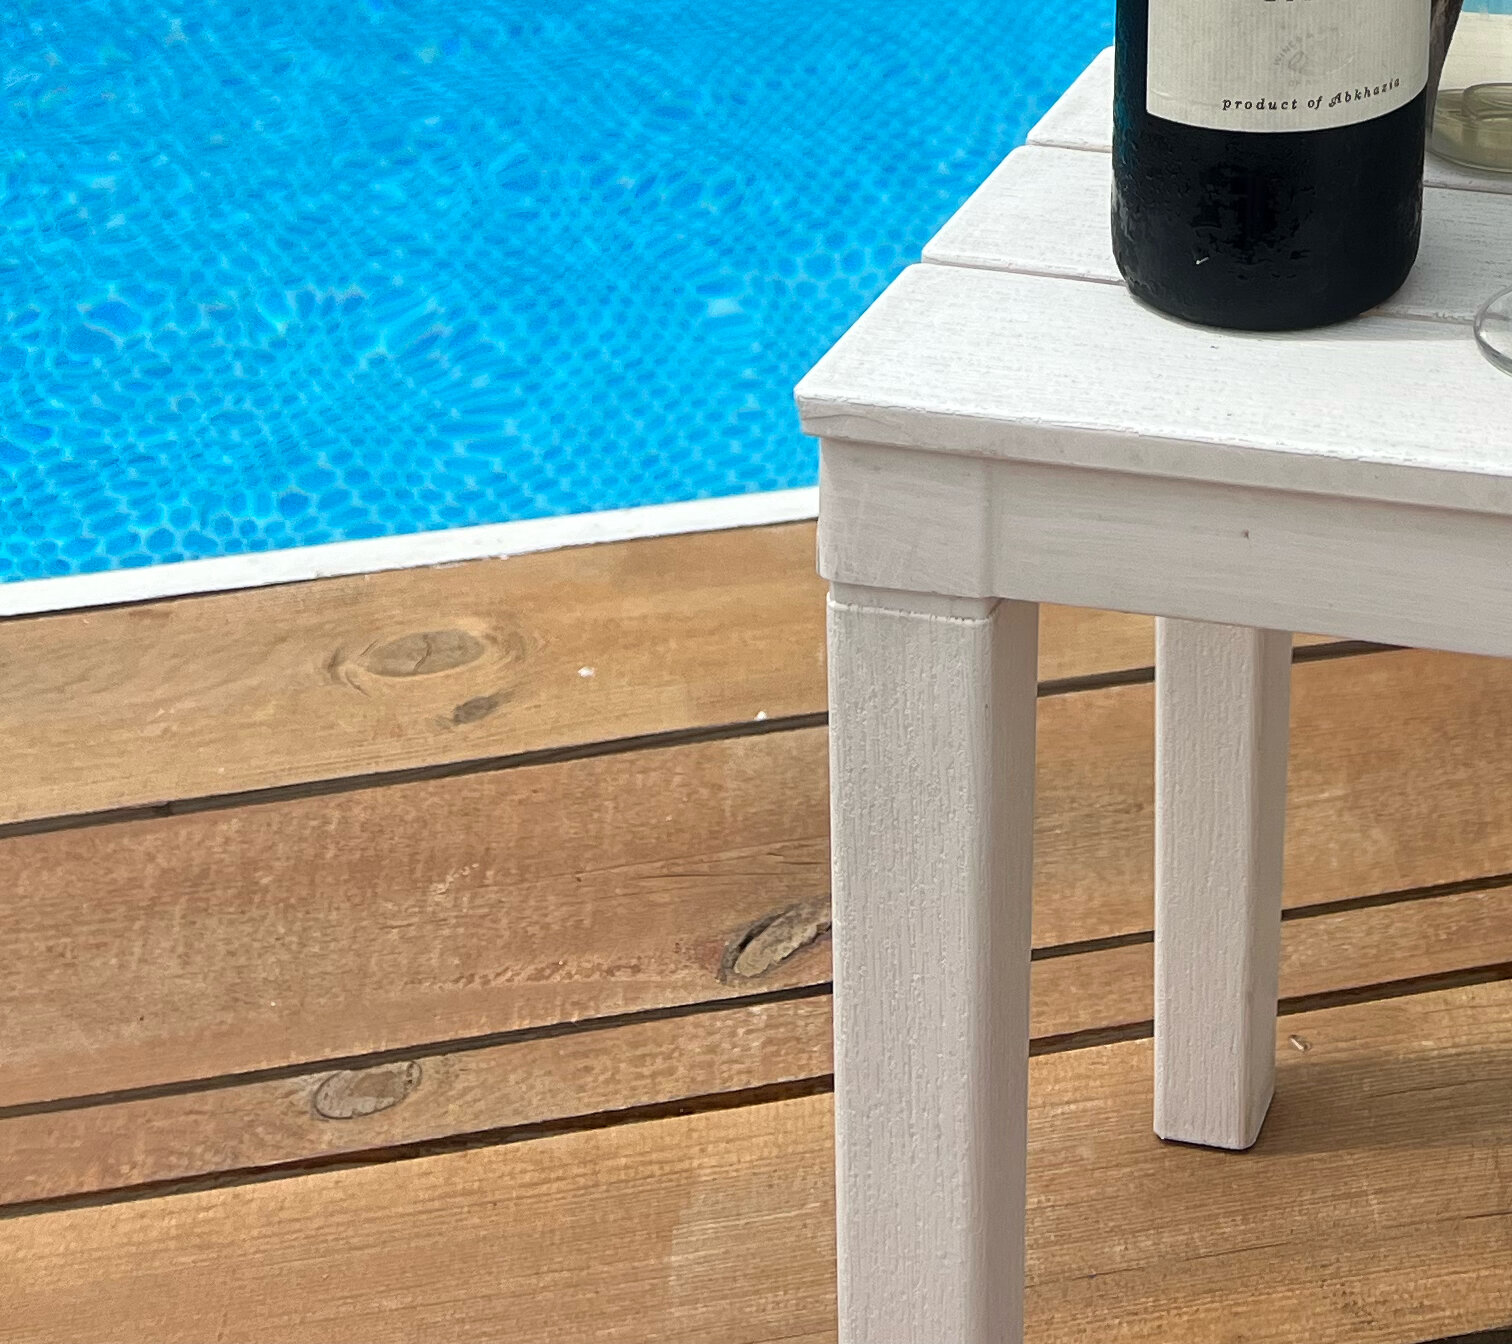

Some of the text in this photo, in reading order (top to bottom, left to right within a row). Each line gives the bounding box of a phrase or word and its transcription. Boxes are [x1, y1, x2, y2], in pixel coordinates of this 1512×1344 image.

[1222, 98, 1298, 111] product
[1307, 96, 1323, 109] of
[1328, 78, 1400, 108] Abkhazia
